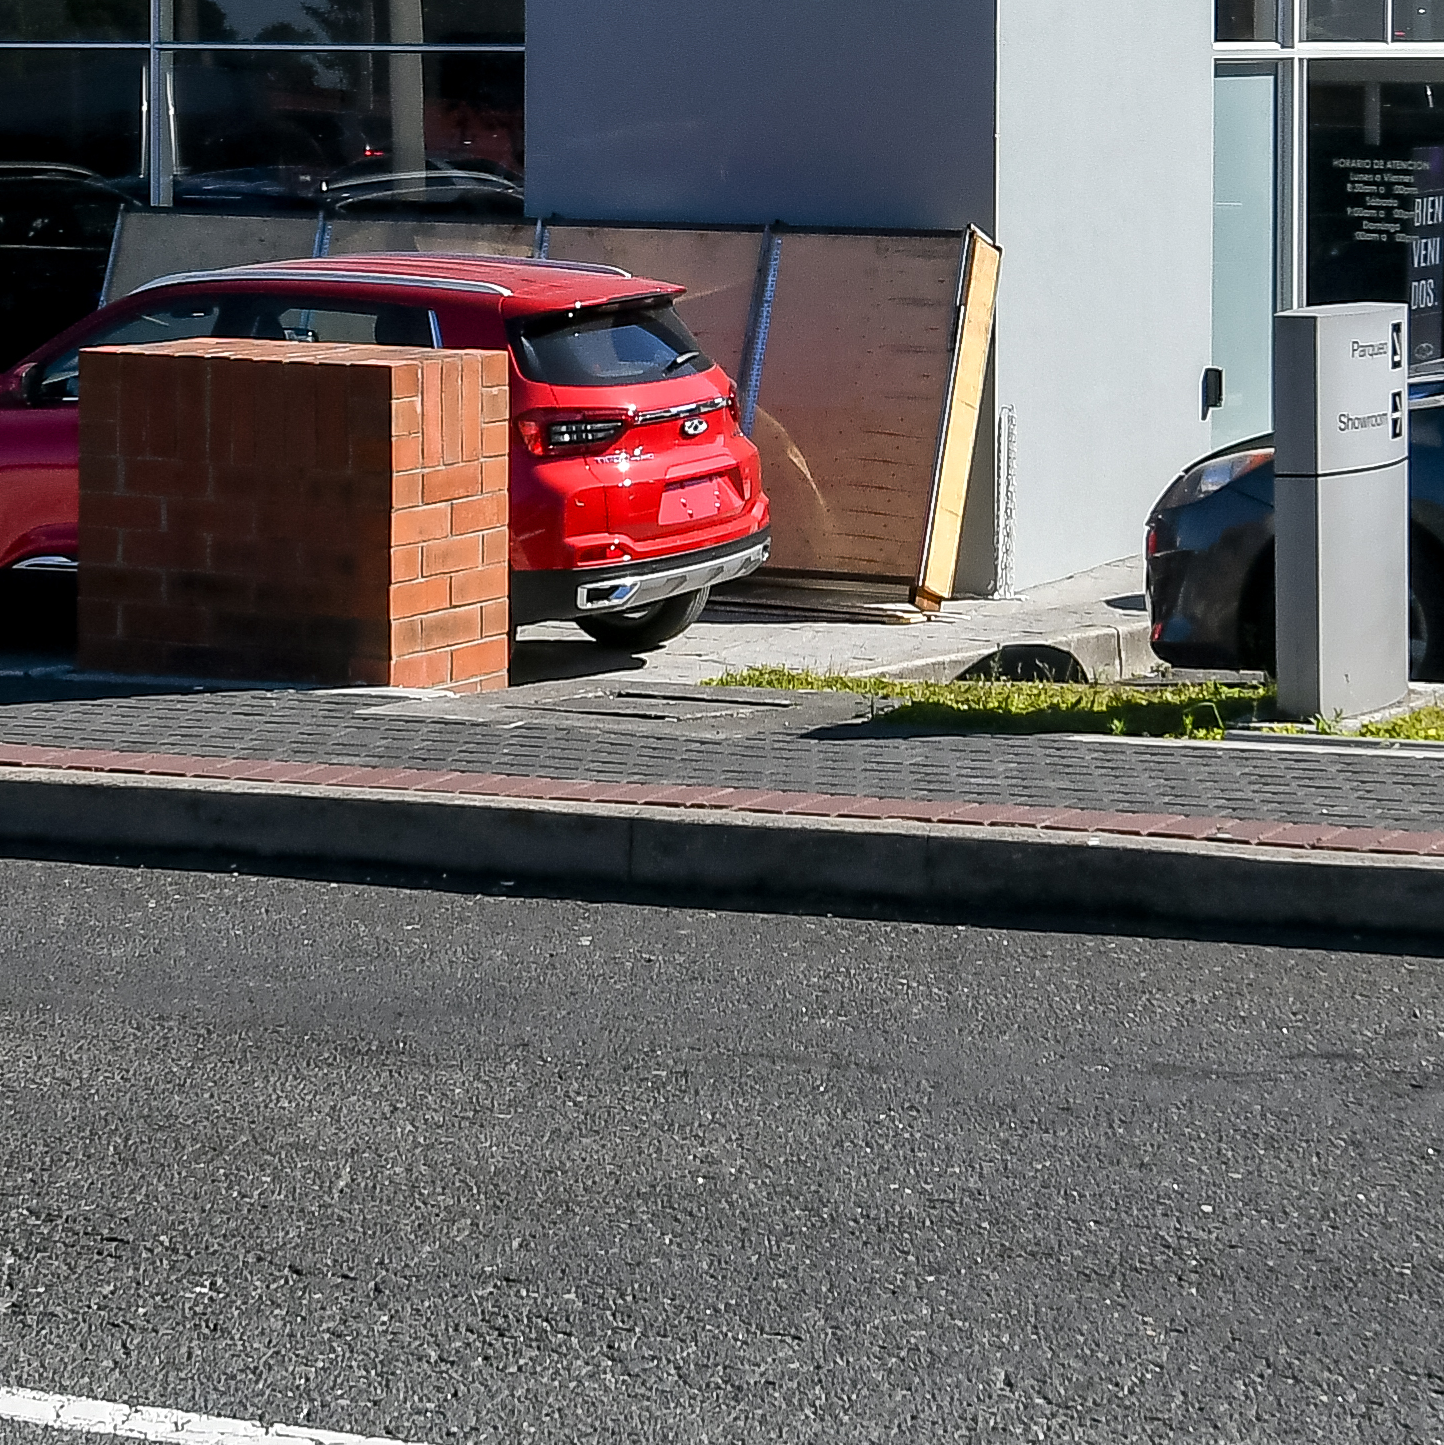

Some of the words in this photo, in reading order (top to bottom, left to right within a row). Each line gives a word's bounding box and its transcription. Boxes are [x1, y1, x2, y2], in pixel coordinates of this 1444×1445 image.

[1414, 196, 1443, 226] BIEN
[1412, 237, 1440, 267] VENI
[1410, 279, 1438, 309] DOS.
